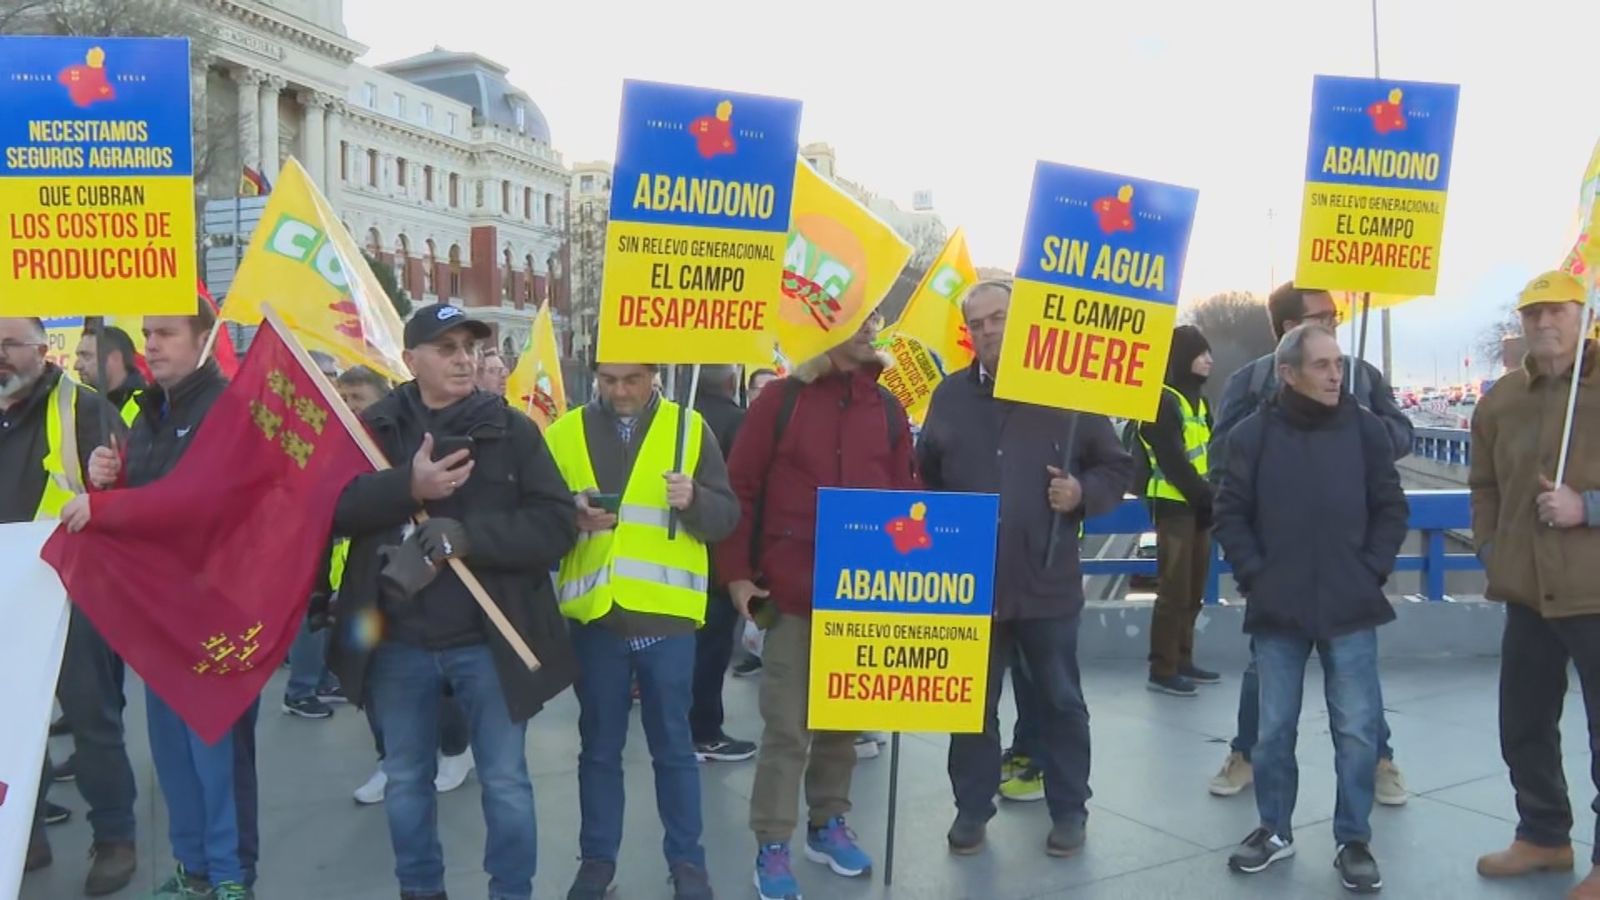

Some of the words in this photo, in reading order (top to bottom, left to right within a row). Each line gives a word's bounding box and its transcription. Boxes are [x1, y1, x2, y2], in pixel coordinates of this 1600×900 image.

[28, 120, 148, 142] NECESITAMOS
[6, 147, 84, 168] SEGUROS
[89, 147, 173, 168] AGRARIOS
[1322, 146, 1440, 182] ABANDONO
[39, 186, 72, 207] QUE
[77, 186, 145, 206] CUBRAN
[633, 173, 775, 219] ABANDONO
[1311, 193, 1328, 207] SIN
[1329, 194, 1367, 209] RELEVO
[1369, 197, 1440, 214] GENERACIONAL
[10, 213, 51, 239] LOS
[56, 213, 138, 238] COSTOS
[145, 213, 171, 238] DE
[1336, 214, 1355, 235] EL
[1359, 215, 1414, 239] CAMPO
[12, 242, 177, 280] PRODUCCIÓN
[618, 235, 640, 253] SIN
[642, 237, 688, 256] RELEVO
[691, 240, 775, 261] GENERACIONAL
[1311, 238, 1433, 270] DESAPARECE
[651, 263, 673, 290] EL
[679, 264, 745, 292] CAMPO
[1040, 235, 1089, 277] SIN
[1092, 244, 1165, 291] AGUA
[618, 295, 767, 331] DESAPARECE
[1043, 293, 1066, 322] EL
[1073, 298, 1145, 335] CAMPO
[1023, 324, 1150, 388] MUERE
[835, 569, 975, 604] ABANDONO
[825, 622, 844, 636] SIN
[847, 623, 890, 638] RELEVO
[894, 625, 979, 641] GENERACIONAL
[856, 645, 878, 667] EL
[884, 646, 948, 669] CAMPO
[828, 673, 973, 703] DESAPARECE
